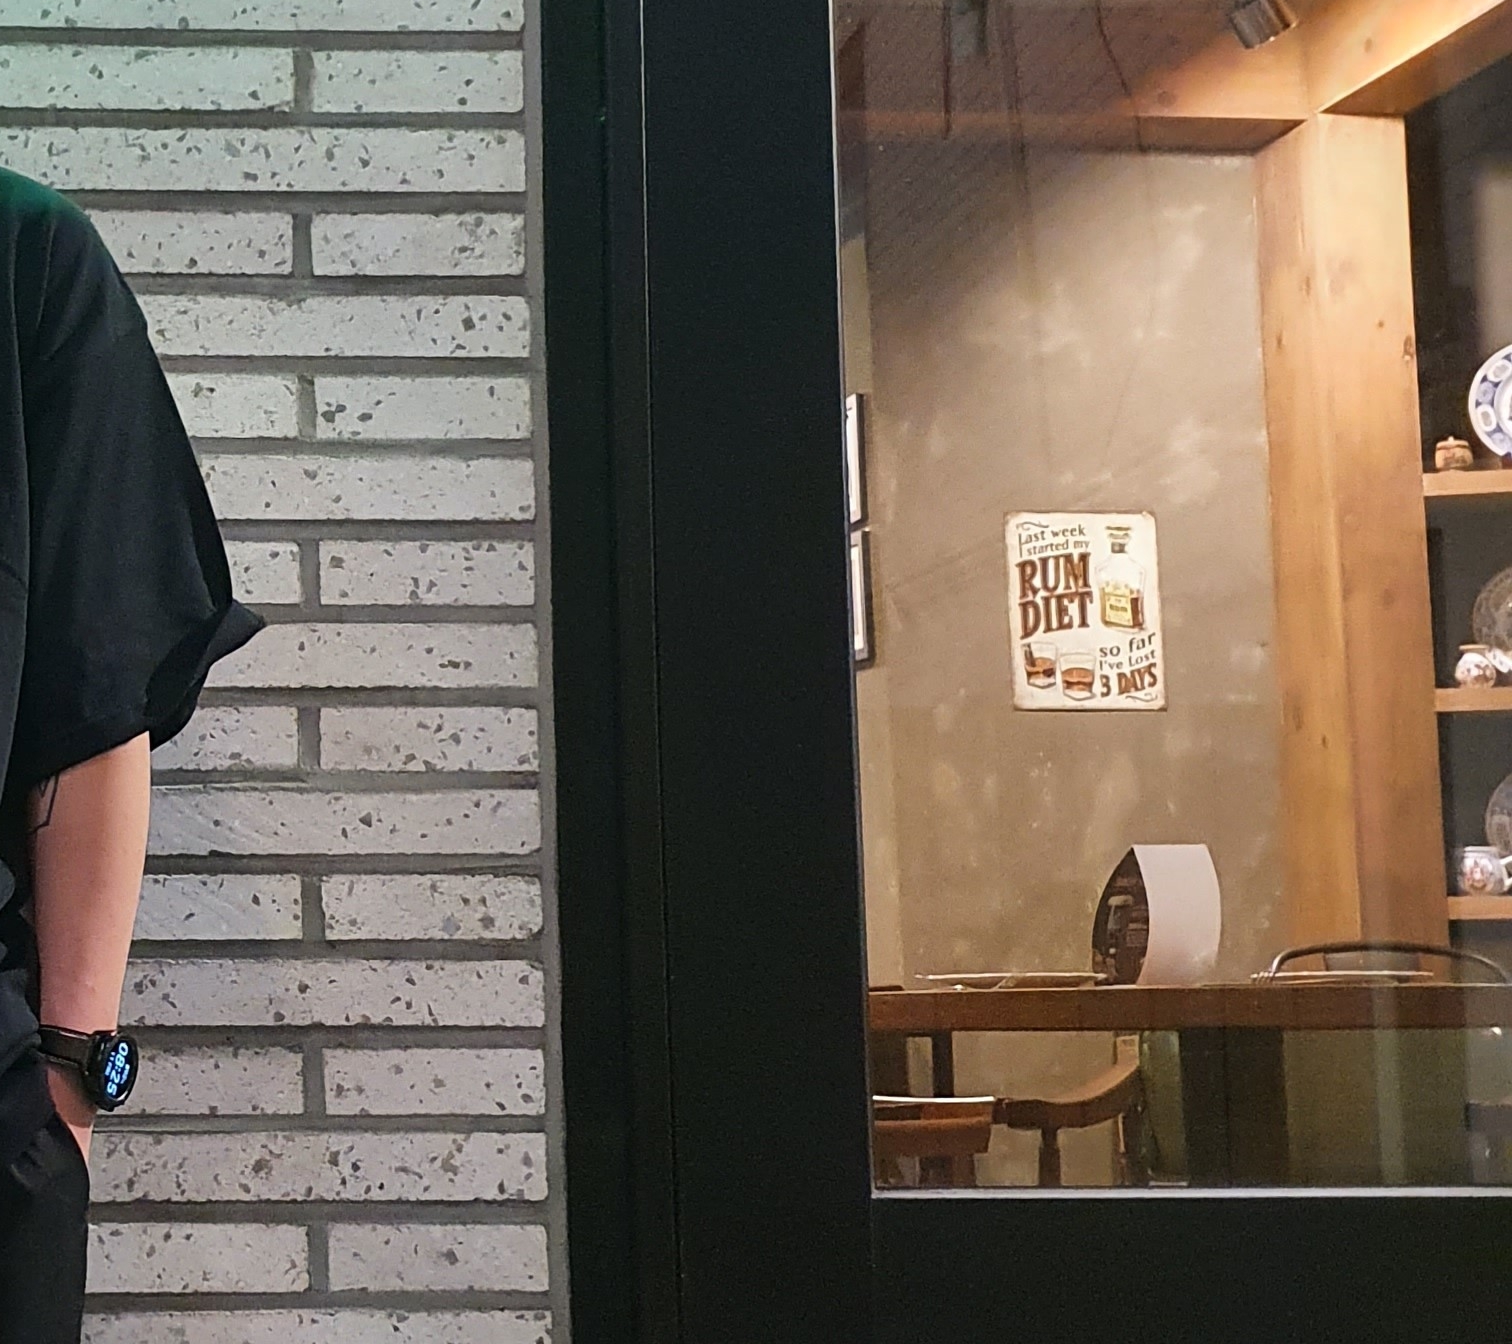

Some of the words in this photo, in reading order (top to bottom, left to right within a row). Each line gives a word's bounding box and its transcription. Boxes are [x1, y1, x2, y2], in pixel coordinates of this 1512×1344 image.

[1018, 530, 1046, 545] Last
[1051, 524, 1086, 538] week
[1026, 539, 1069, 556] started
[1073, 540, 1090, 551] my
[1016, 552, 1092, 600] RUM
[1018, 590, 1093, 640] DIET
[1099, 645, 1121, 658] so
[1128, 632, 1156, 653] far
[1099, 660, 1123, 671] I've
[1099, 673, 1111, 698] 3
[1116, 662, 1158, 695] DAYS
[107, 1042, 129, 1096] 08:25
